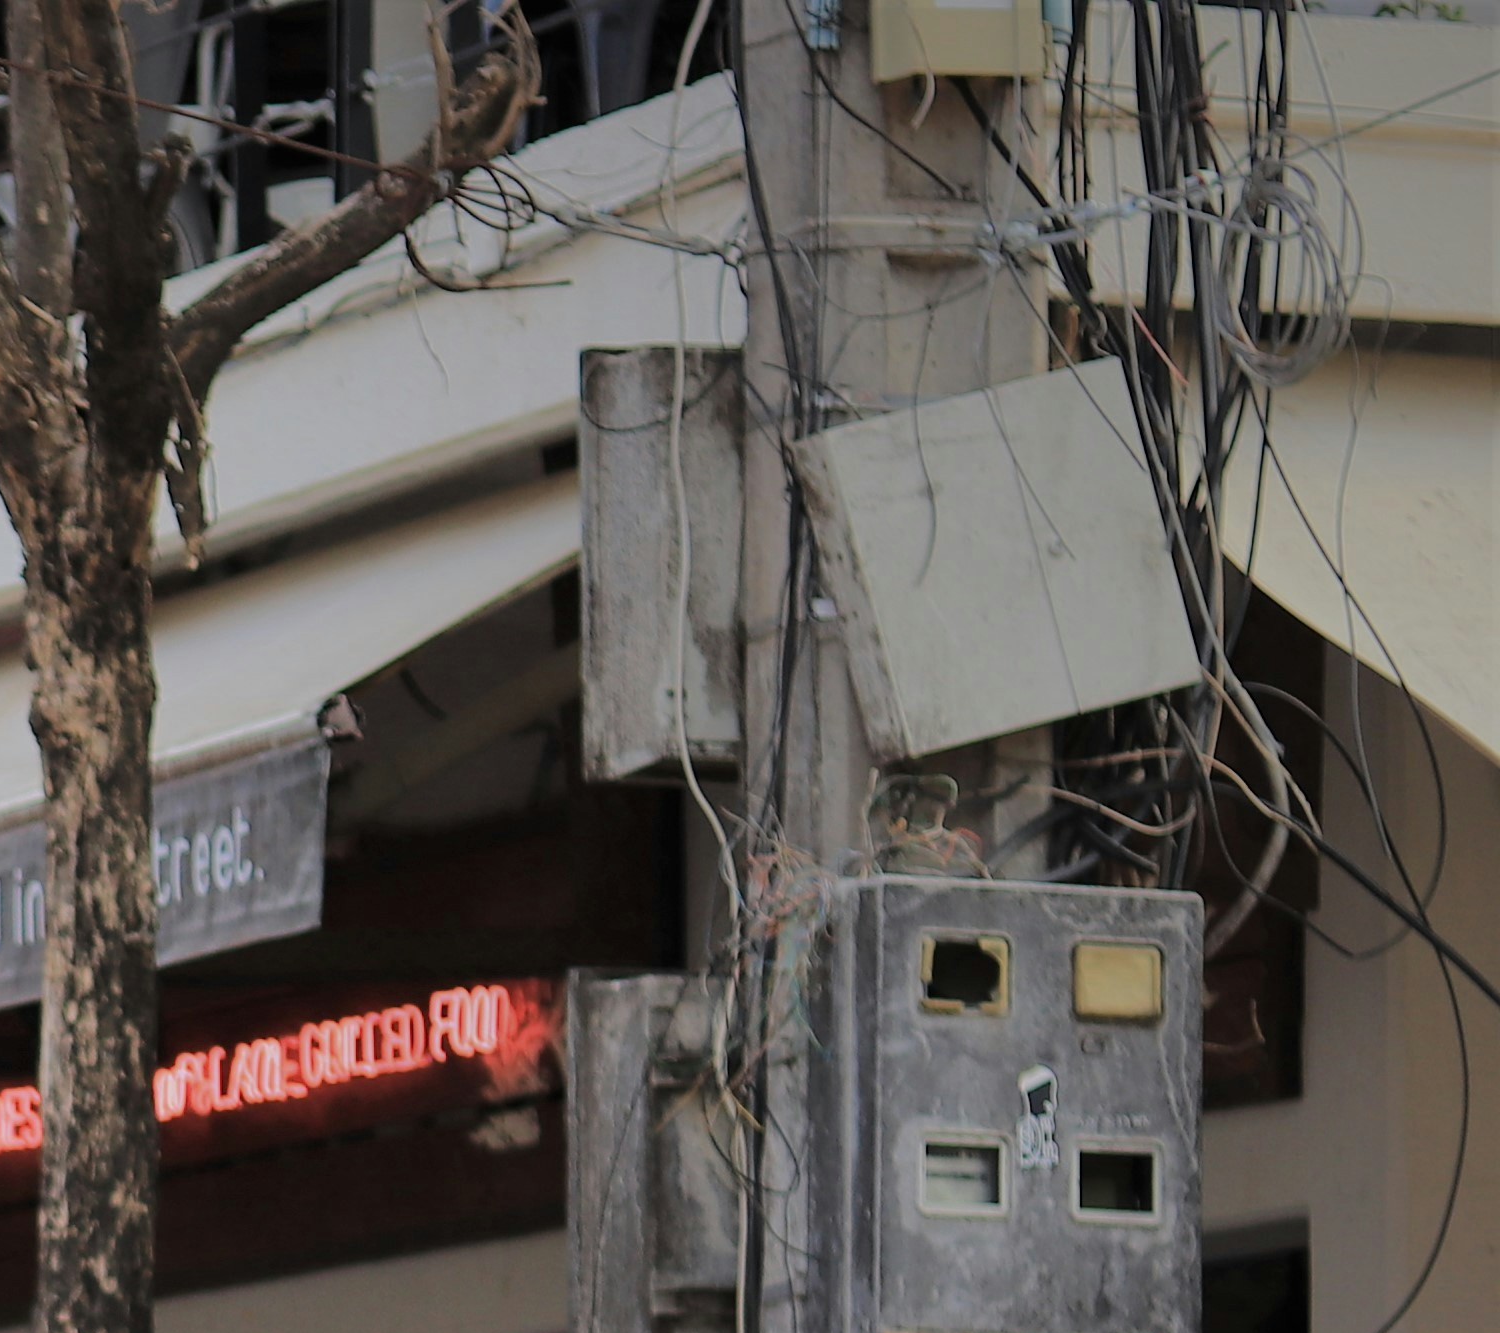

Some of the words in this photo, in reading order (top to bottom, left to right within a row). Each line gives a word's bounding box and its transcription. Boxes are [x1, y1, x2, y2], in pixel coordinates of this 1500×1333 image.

[11, 867, 46, 947] in
[153, 806, 266, 908] treet.
[430, 984, 512, 1062] FOOD
